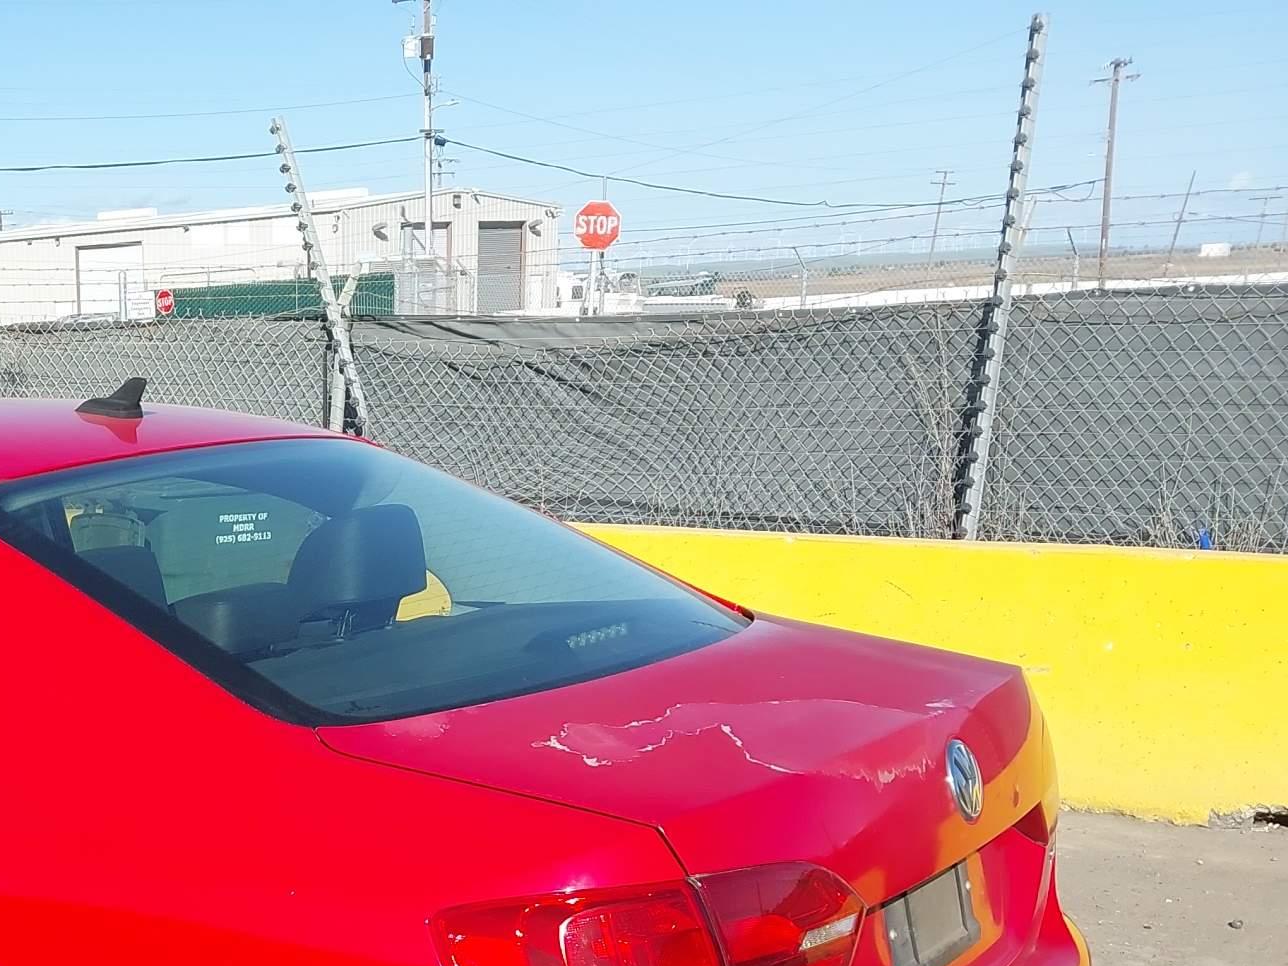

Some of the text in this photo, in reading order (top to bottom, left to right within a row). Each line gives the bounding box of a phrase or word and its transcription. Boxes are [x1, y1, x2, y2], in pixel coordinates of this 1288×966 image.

[576, 215, 618, 234] STOP
[157, 296, 173, 307] STOP
[219, 512, 268, 523] PROPERTY OF
[215, 535, 236, 544] (925)
